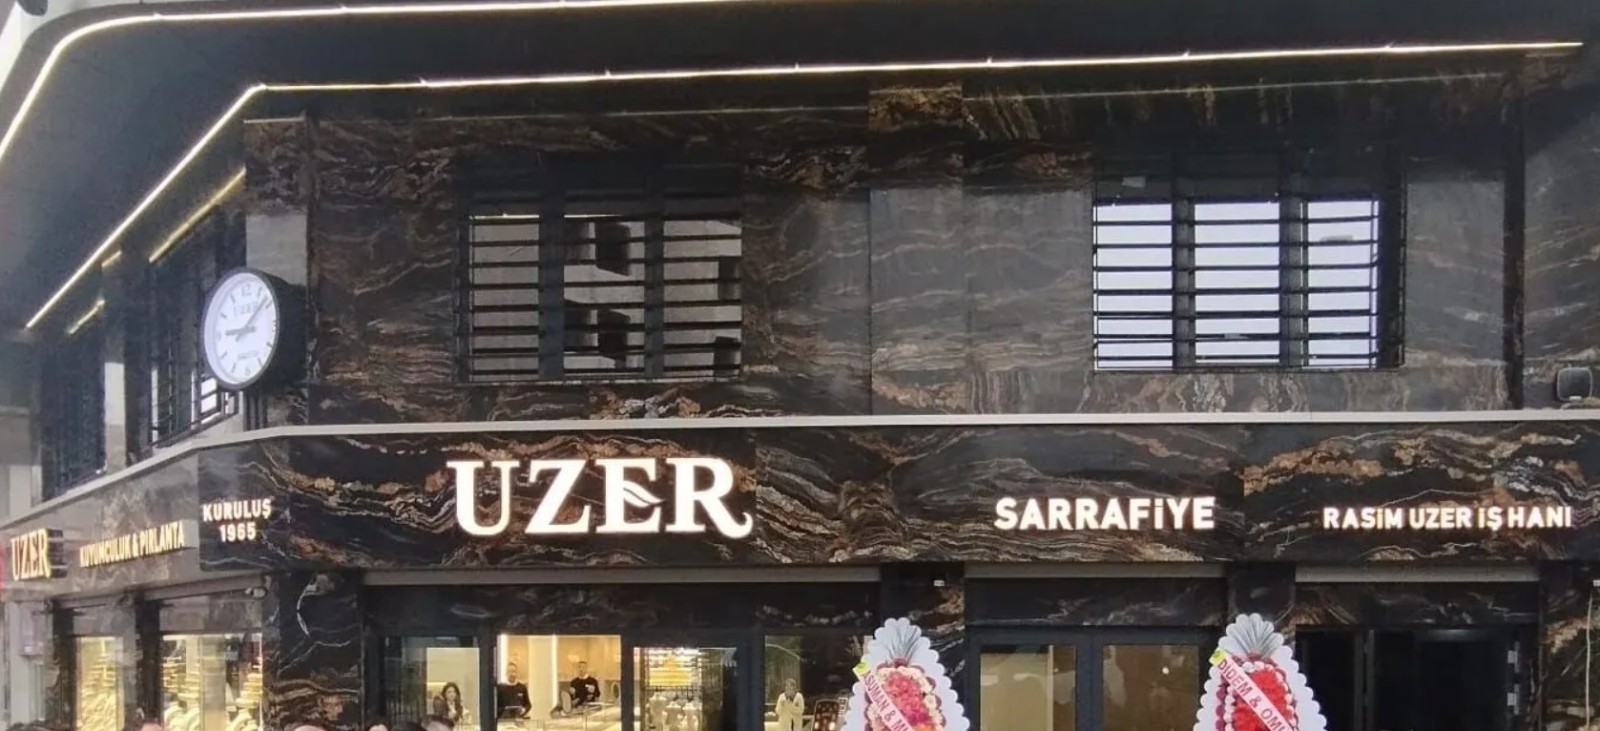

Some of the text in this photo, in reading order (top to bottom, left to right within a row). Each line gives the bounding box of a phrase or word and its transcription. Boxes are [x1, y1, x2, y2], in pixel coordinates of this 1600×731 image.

[241, 283, 252, 296] 12
[203, 498, 272, 523] KURULUŞ
[446, 457, 754, 539] UZER
[1409, 506, 1472, 530] UZER
[1507, 505, 1573, 528] HANI
[219, 521, 257, 543] 1965
[11, 528, 51, 582] UZER
[131, 533, 140, 558] &
[1249, 695, 1262, 708] &
[884, 709, 897, 722] &
